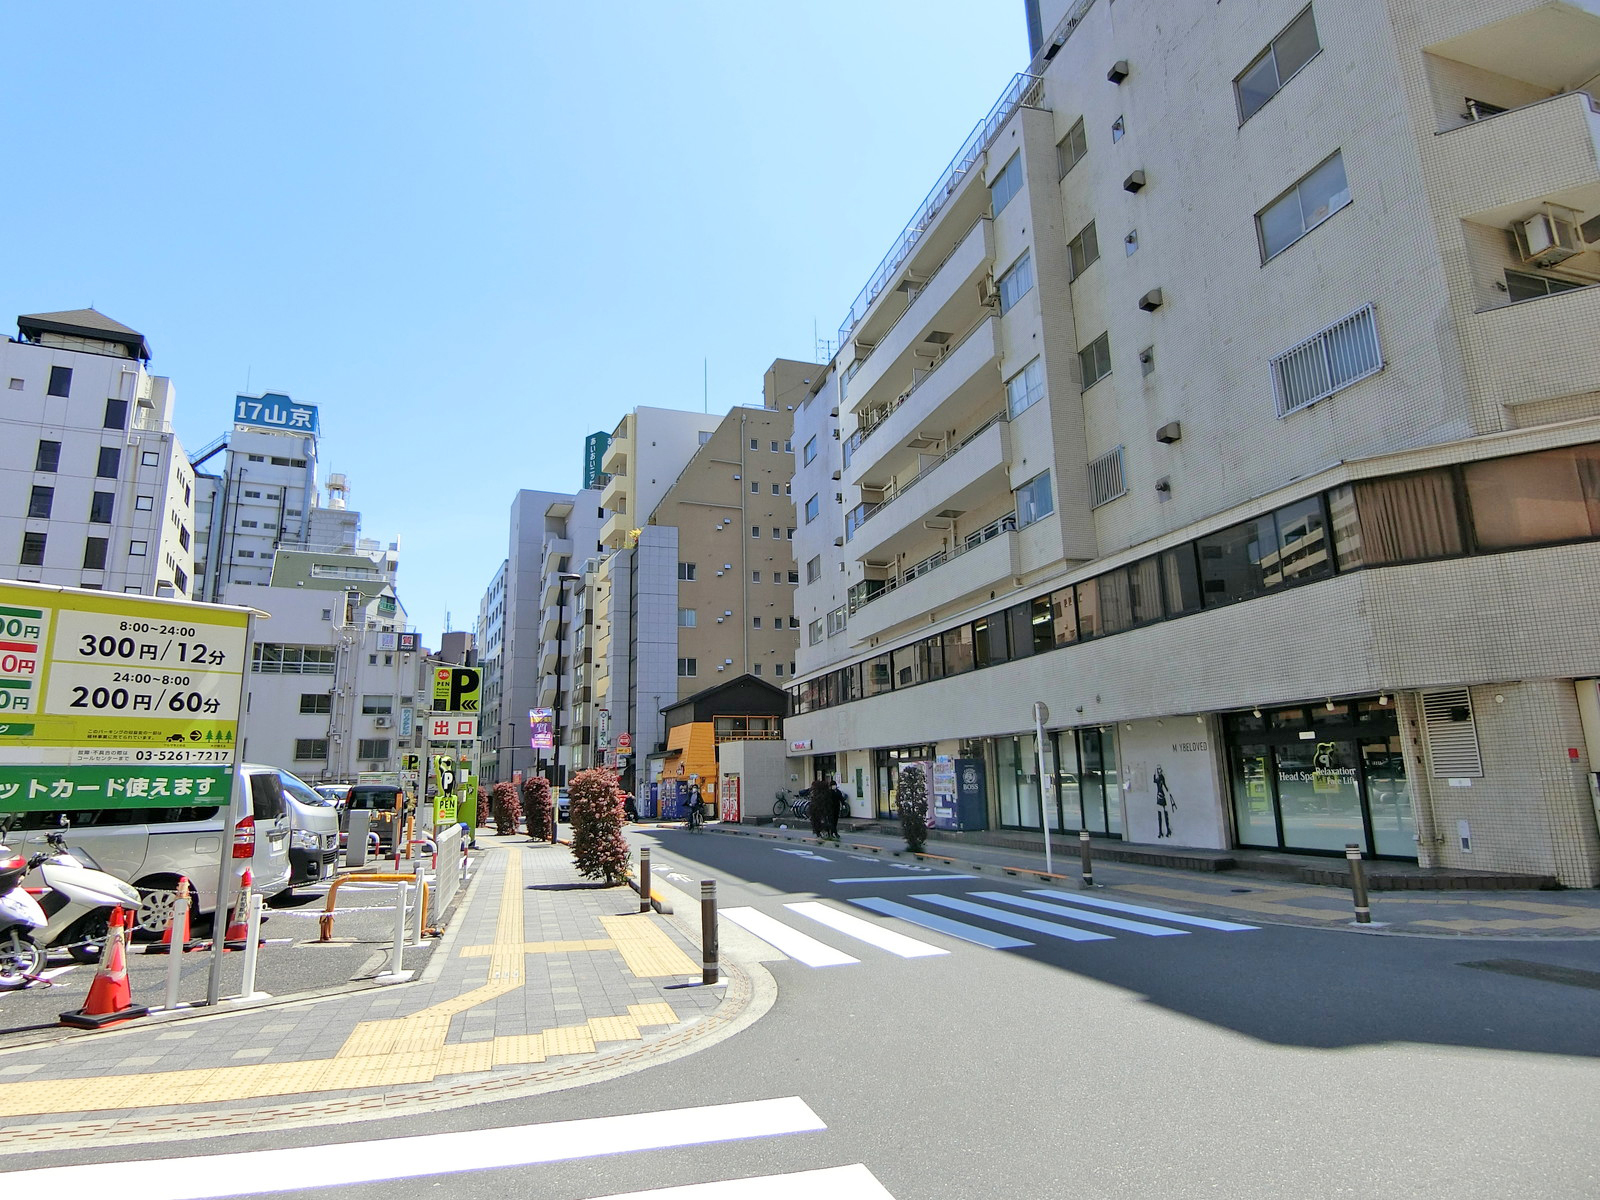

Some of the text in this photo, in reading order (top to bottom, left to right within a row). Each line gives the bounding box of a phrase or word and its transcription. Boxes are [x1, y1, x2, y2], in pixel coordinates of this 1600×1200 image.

[237, 401, 313, 428] 17山京
[449, 668, 480, 711] P
[434, 720, 472, 736] 出口
[135, 750, 229, 762] 03-5261-7217
[408, 755, 418, 770] P
[1278, 771, 1314, 784] Head Spa
[1315, 766, 1356, 776] Relaxation
[444, 772, 454, 790] P
[439, 799, 455, 810] PEN
